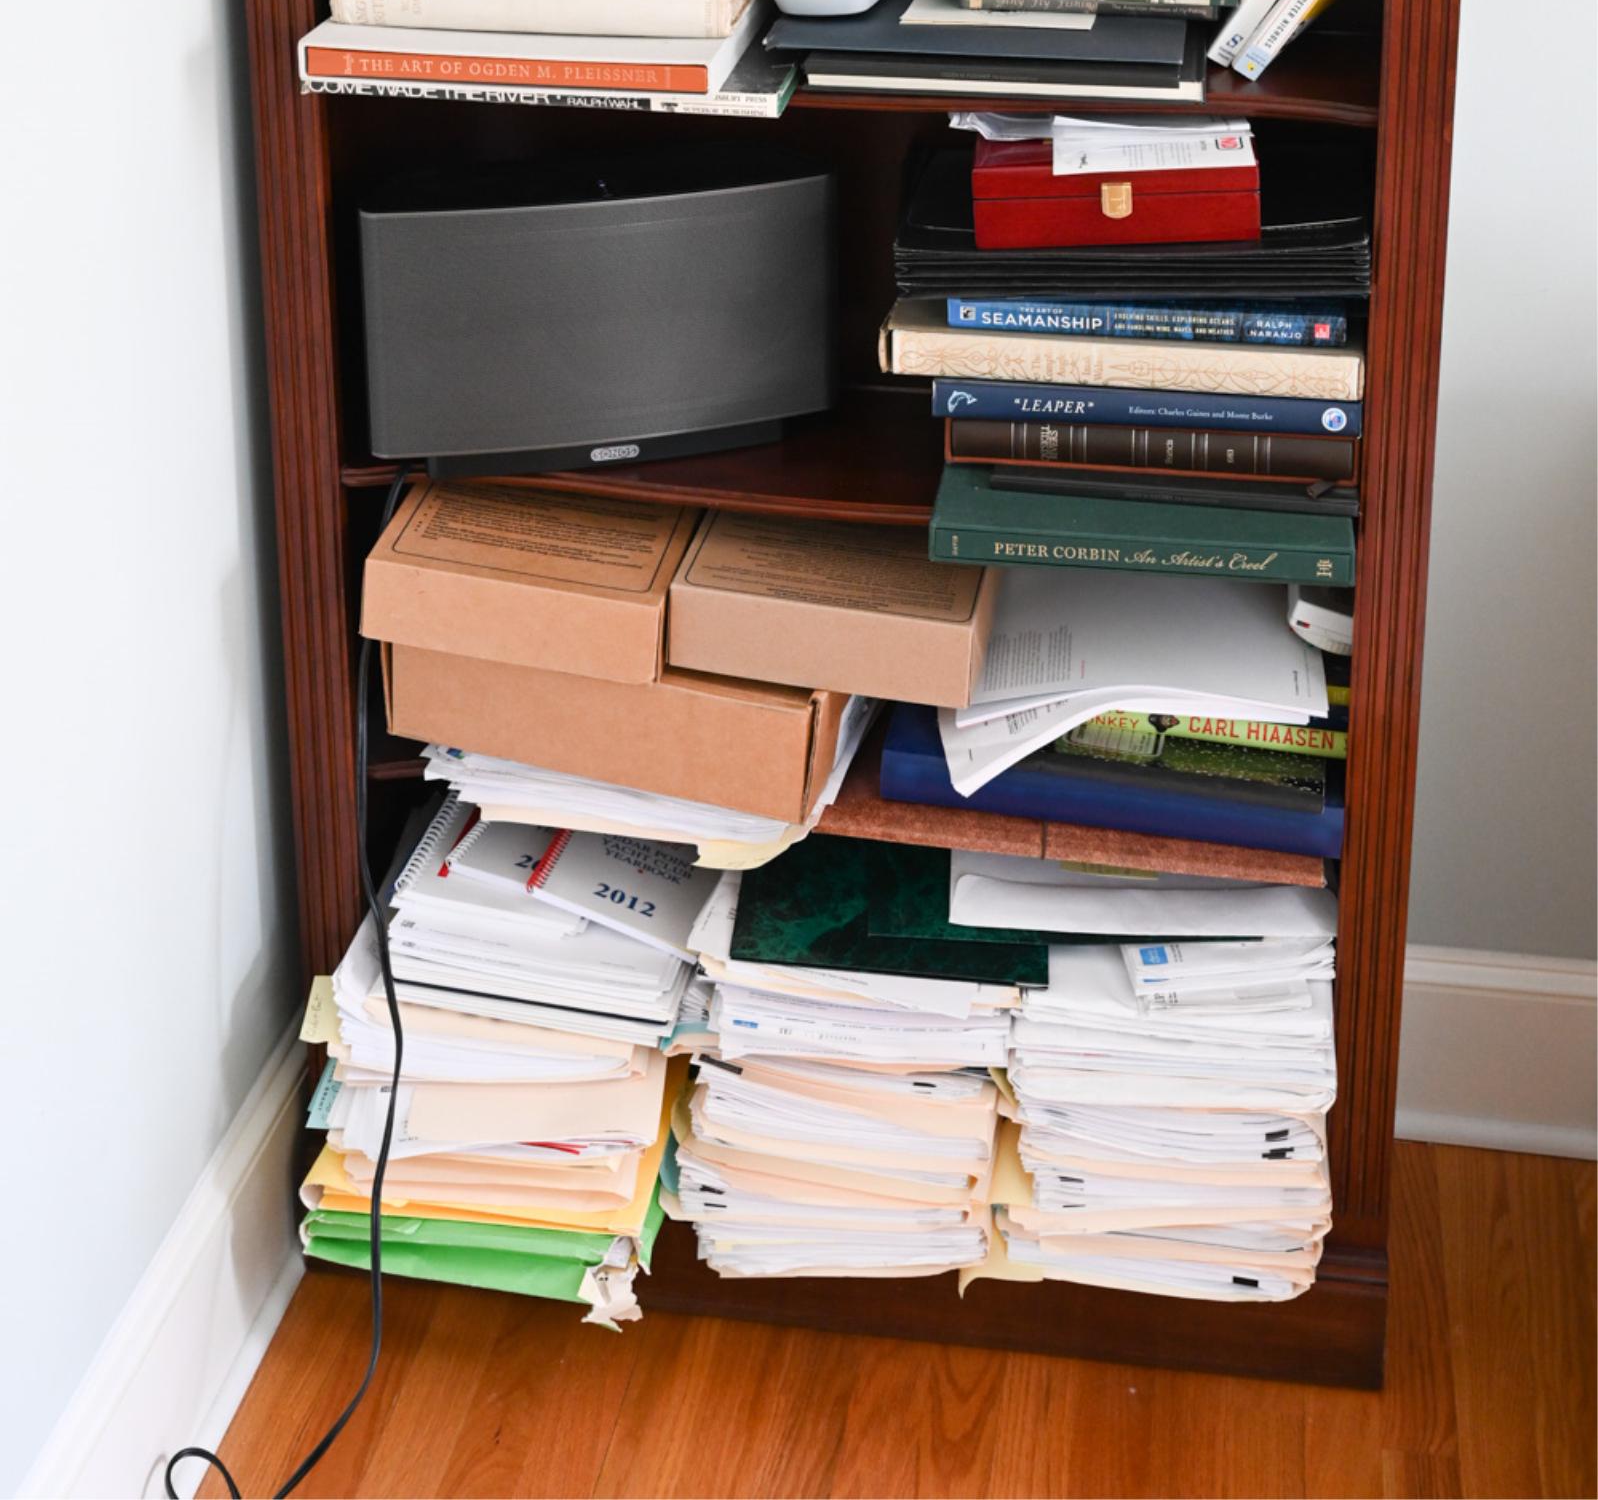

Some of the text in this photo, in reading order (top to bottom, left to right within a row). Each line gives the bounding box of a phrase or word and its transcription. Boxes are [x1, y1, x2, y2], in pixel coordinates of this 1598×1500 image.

[359, 59, 658, 83] THE ART OF OGDEN M. PLEISSNER
[566, 96, 643, 110] RALPH WAHL
[981, 311, 1102, 331] SEAMANSHIP
[1256, 320, 1292, 329] RALPH
[1249, 329, 1302, 339] NARANJO
[1129, 406, 1156, 415] Editors:
[1159, 407, 1185, 416] Charles
[1187, 408, 1210, 417] Gaines
[1226, 410, 1249, 419] Monte
[1251, 411, 1273, 420] Burke
[592, 447, 637, 460] SONOS
[994, 542, 1048, 558] PETER
[1053, 545, 1120, 562] CORBIN
[1124, 550, 1157, 564] An
[1228, 552, 1278, 572] Creel
[1188, 716, 1335, 750] CARL HIAASEN
[602, 838, 692, 880] YACHT CLUB
[604, 848, 681, 885] YEARBOOK
[593, 882, 656, 918] 2012
